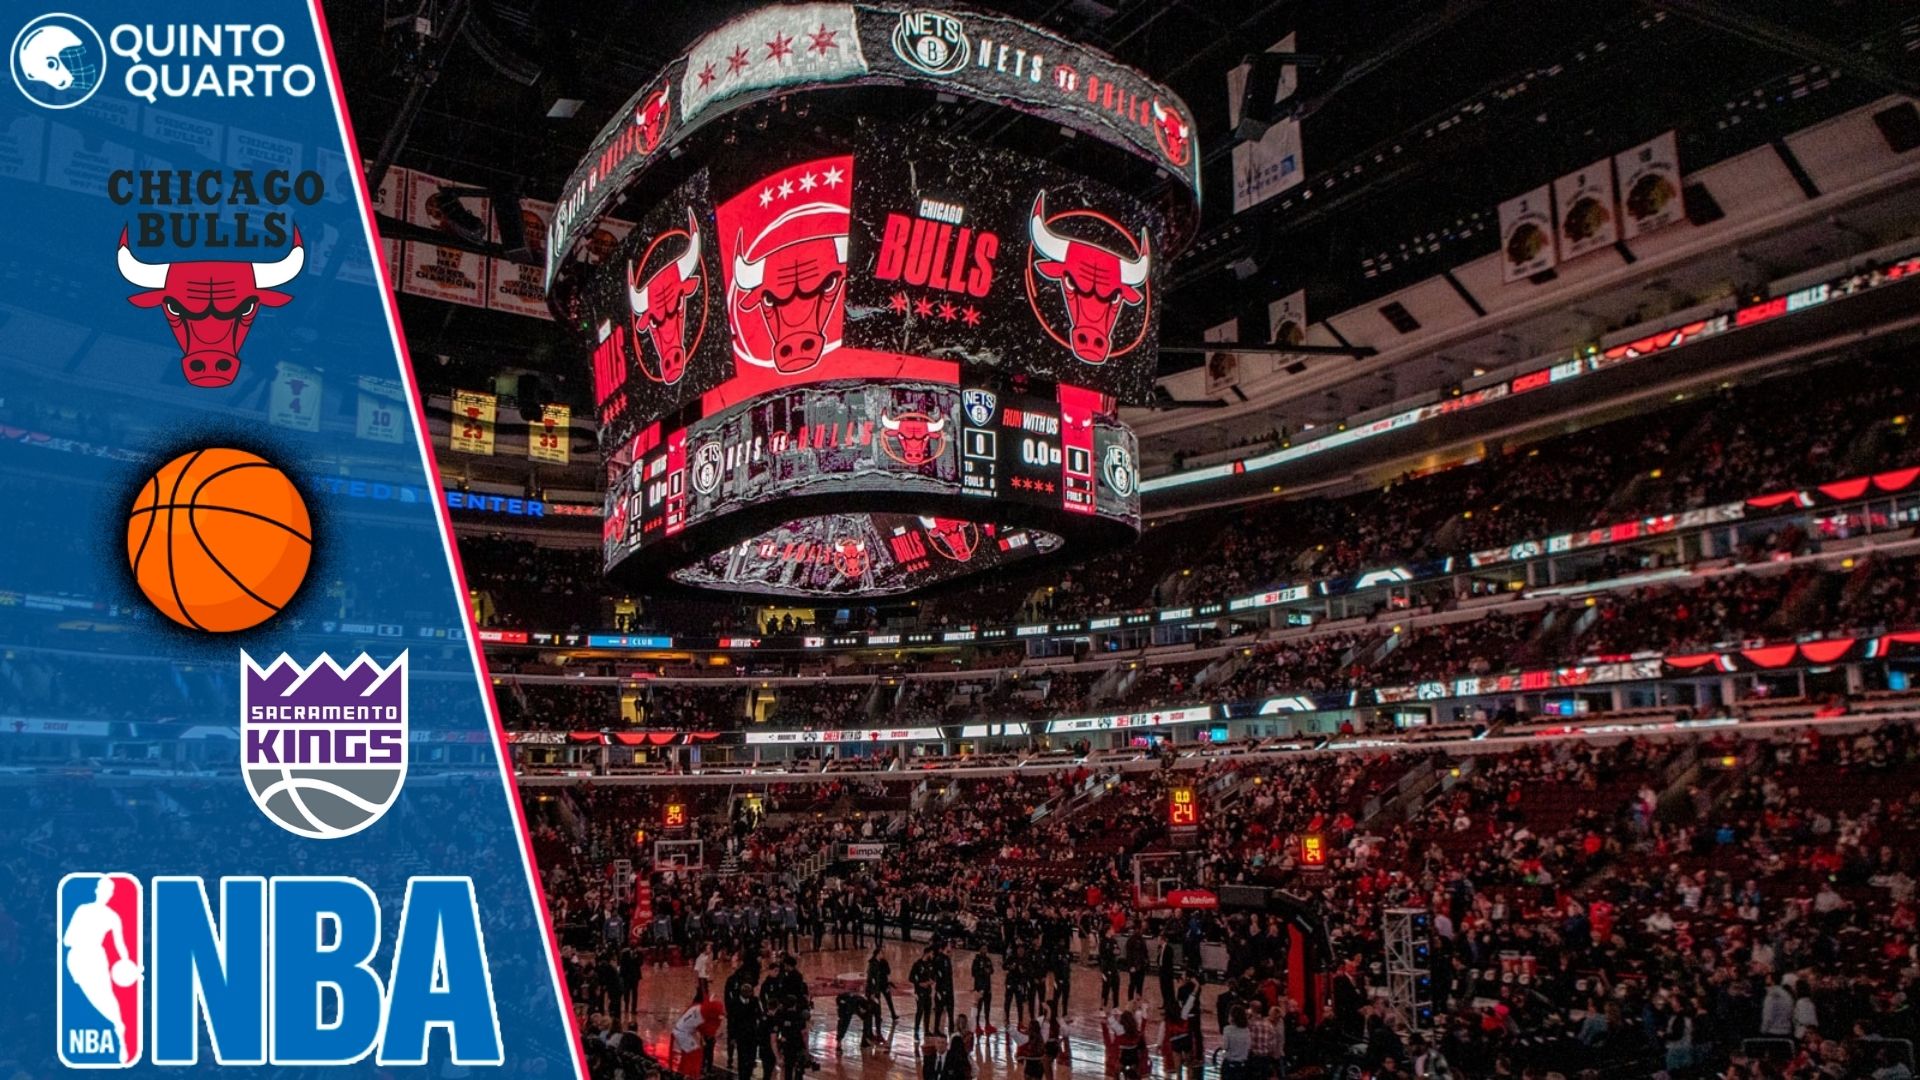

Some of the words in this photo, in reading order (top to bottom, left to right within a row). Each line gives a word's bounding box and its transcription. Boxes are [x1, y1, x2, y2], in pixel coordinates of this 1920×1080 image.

[904, 14, 959, 43] NETS
[928, 40, 937, 62] B
[978, 39, 1043, 83] NETS
[1058, 70, 1075, 91] VS
[1087, 75, 1150, 127] BULLS
[919, 200, 964, 224] CHICAGO
[875, 213, 999, 298] BULLS
[965, 391, 993, 409] NETS
[372, 410, 390, 427] 10
[1003, 408, 1022, 428] RUN
[1022, 411, 1046, 433] WITH
[1046, 416, 1059, 435] US
[463, 422, 483, 440] 23
[539, 433, 558, 449] 33
[798, 421, 875, 451] BULLS
[1023, 438, 1049, 466] 0.0
[447, 491, 545, 517] ENTER
[666, 813, 683, 825] 24
[1173, 803, 1193, 823] 24
